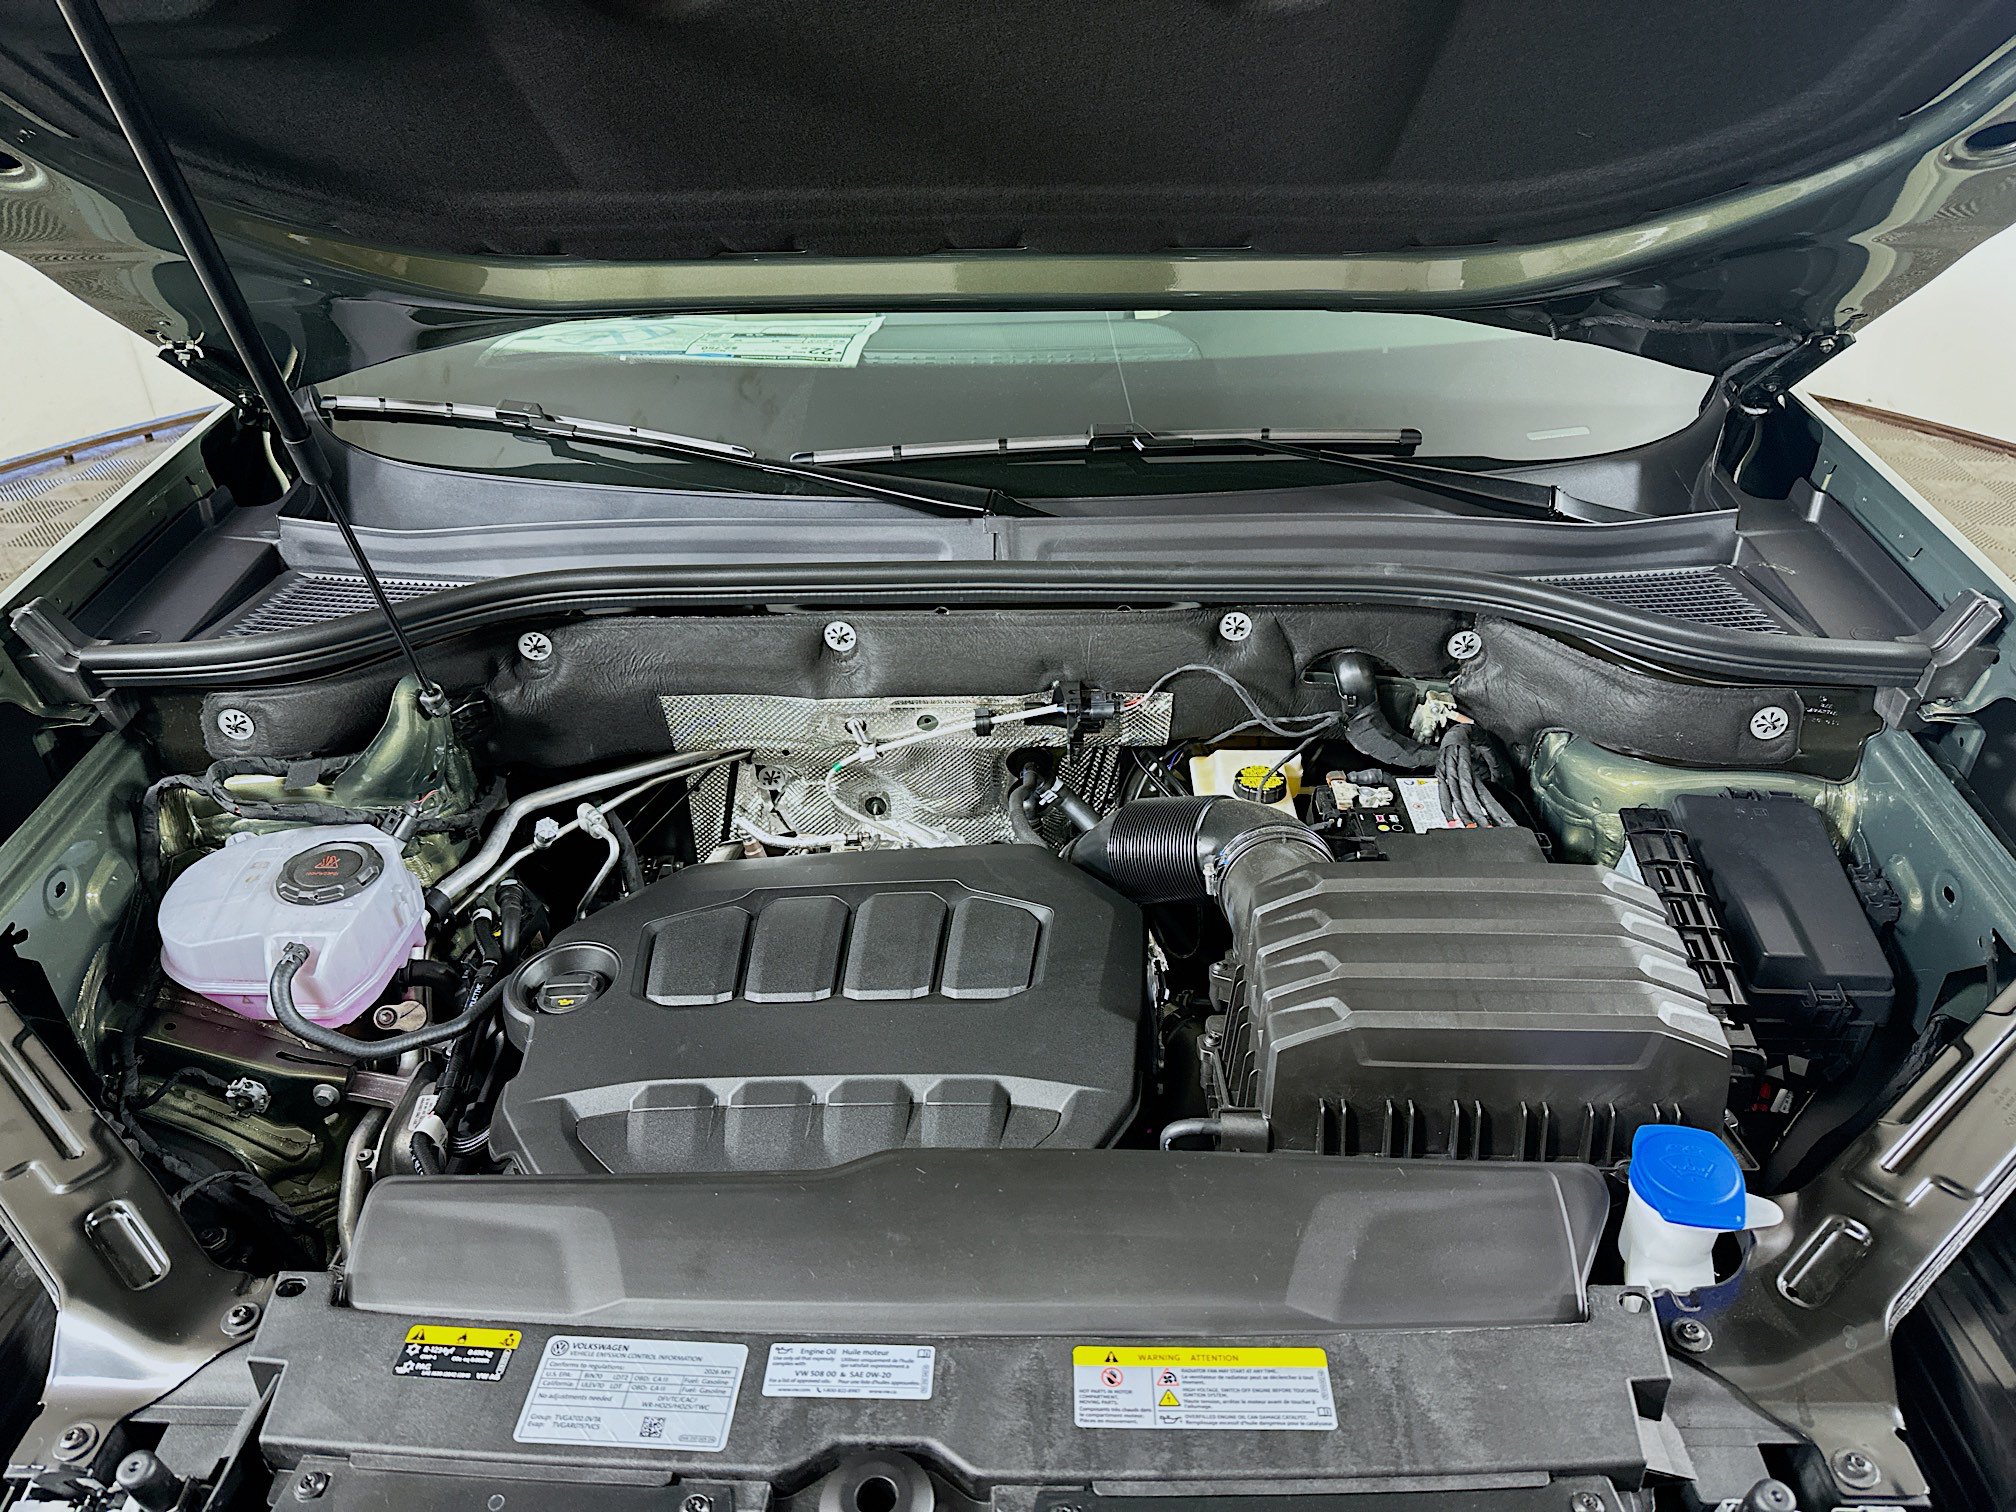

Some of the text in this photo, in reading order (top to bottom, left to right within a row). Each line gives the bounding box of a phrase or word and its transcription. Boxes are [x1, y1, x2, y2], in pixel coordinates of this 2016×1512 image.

[573, 1343, 629, 1351] VOLKSWAGEN
[658, 1354, 703, 1362] INFORMATION
[1138, 1354, 1180, 1362] WARNING
[548, 1393, 587, 1401] adjustments
